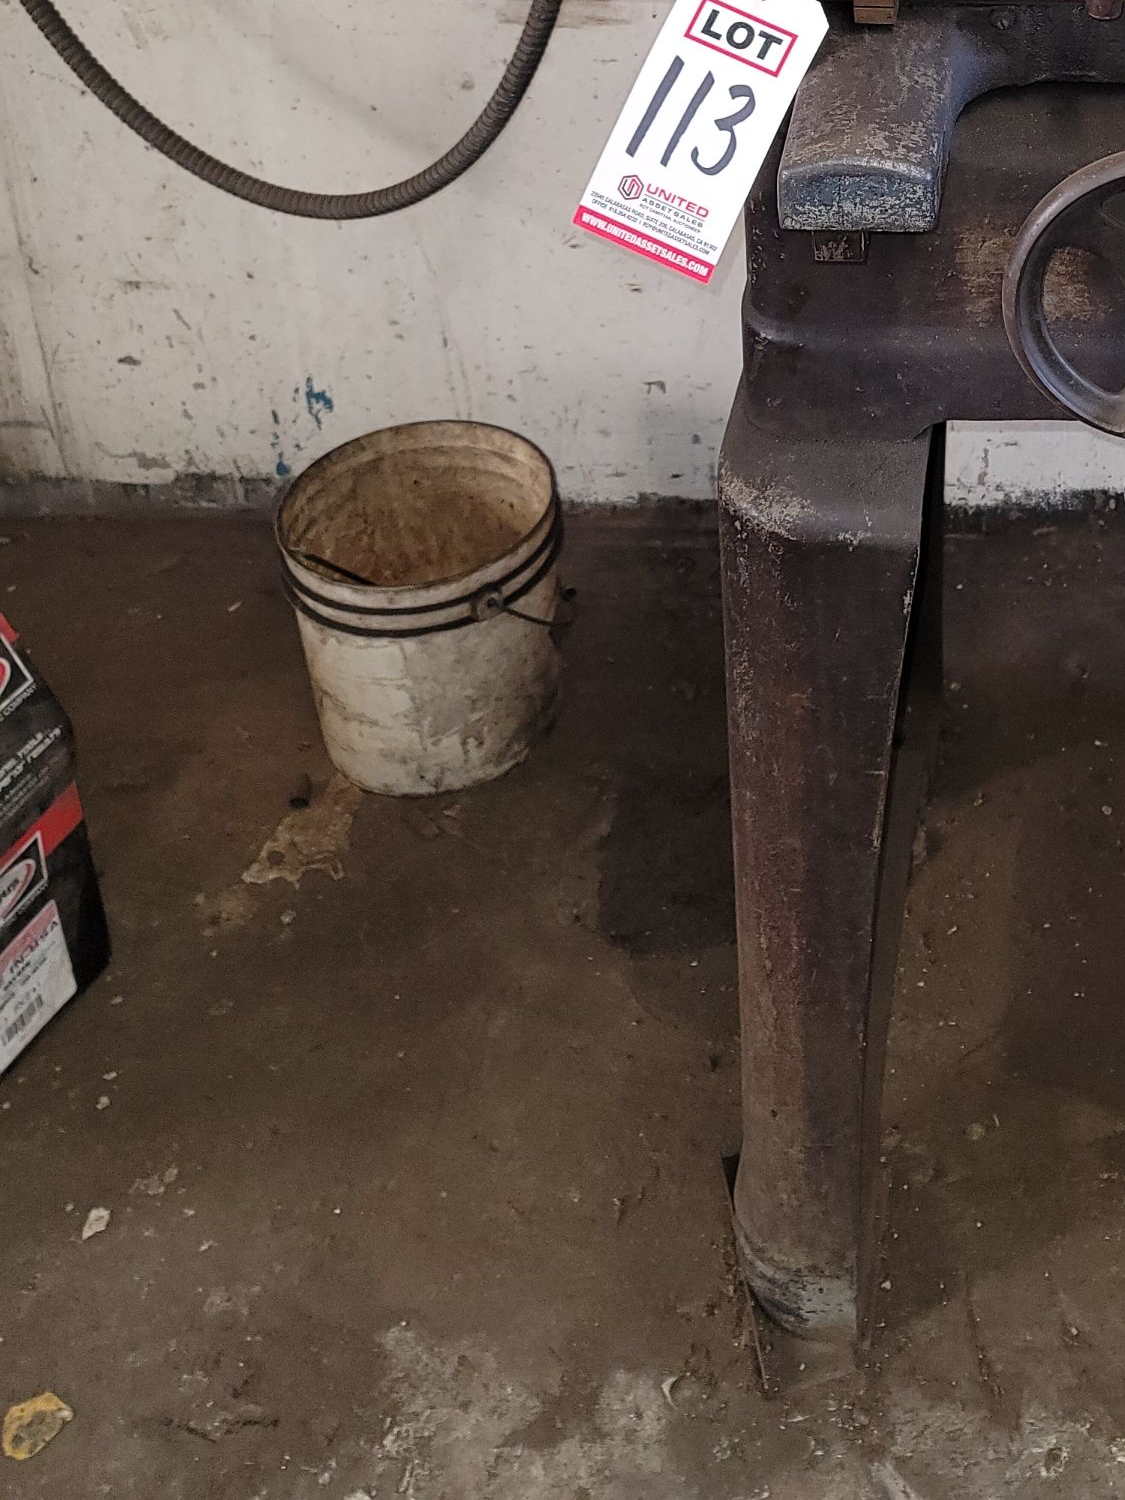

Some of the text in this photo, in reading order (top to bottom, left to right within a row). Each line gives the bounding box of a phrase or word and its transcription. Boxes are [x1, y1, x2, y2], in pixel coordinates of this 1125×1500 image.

[700, 9, 784, 61] LOT
[625, 55, 756, 176] 113
[646, 183, 709, 218] UNITED
[581, 212, 710, 277] WWW.UNITEDASSETSALES.COM
